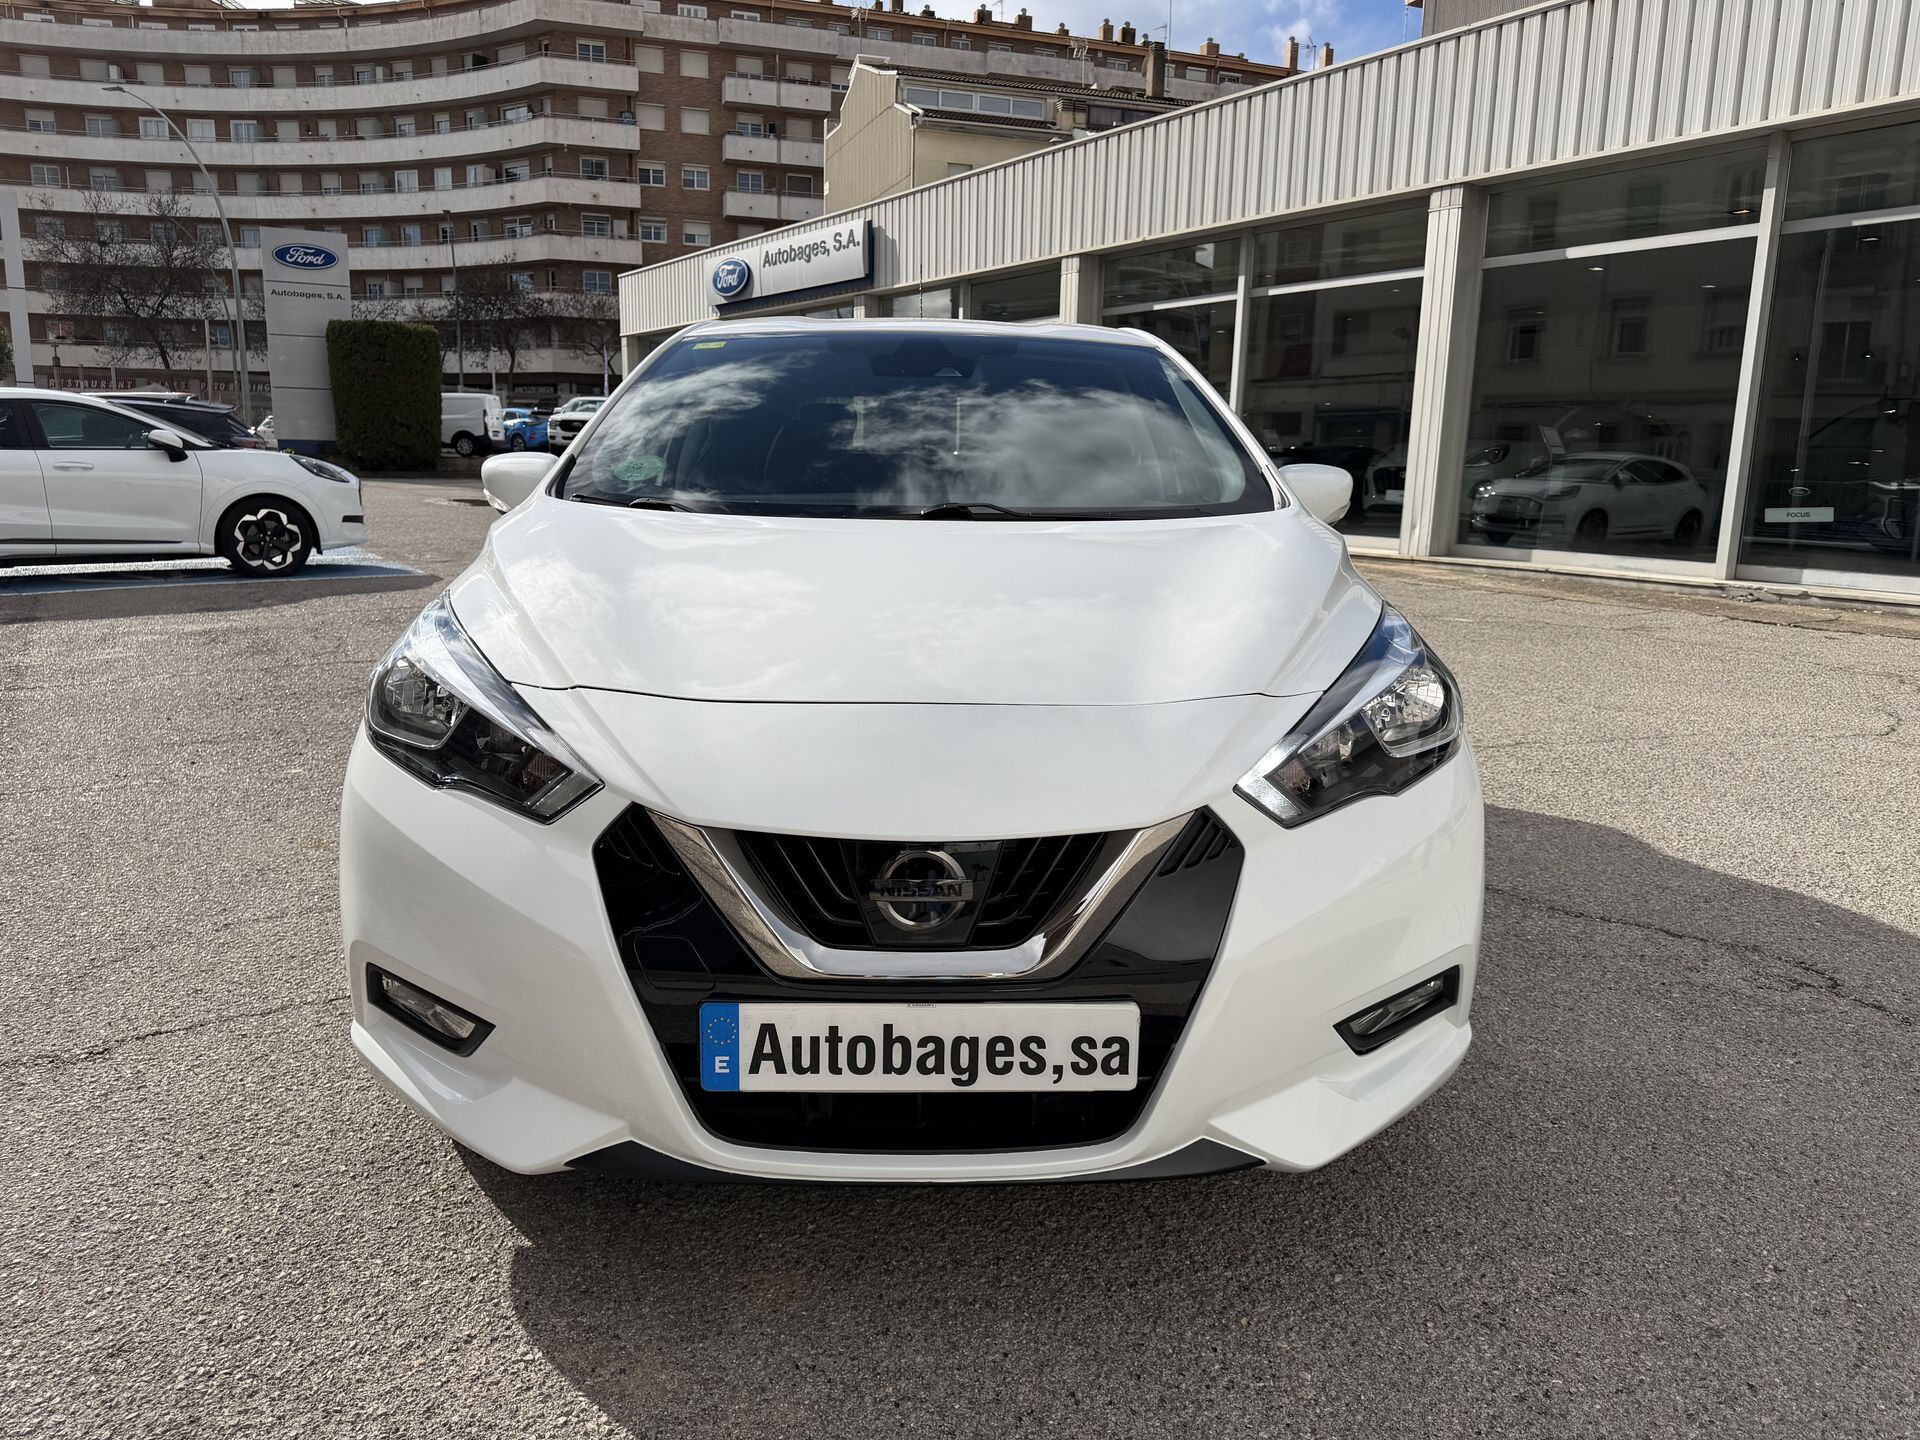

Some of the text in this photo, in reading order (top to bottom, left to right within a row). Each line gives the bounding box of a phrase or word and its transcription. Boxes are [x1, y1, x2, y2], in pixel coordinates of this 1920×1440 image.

[285, 246, 325, 265] Ford
[762, 229, 860, 268] Autobages, S.A.
[716, 264, 742, 289] Ford
[270, 288, 346, 301] Autobages, S.A.
[880, 884, 963, 897] NISSAN
[748, 1022, 1130, 1087] Autobages,sa
[714, 1056, 730, 1074] E
